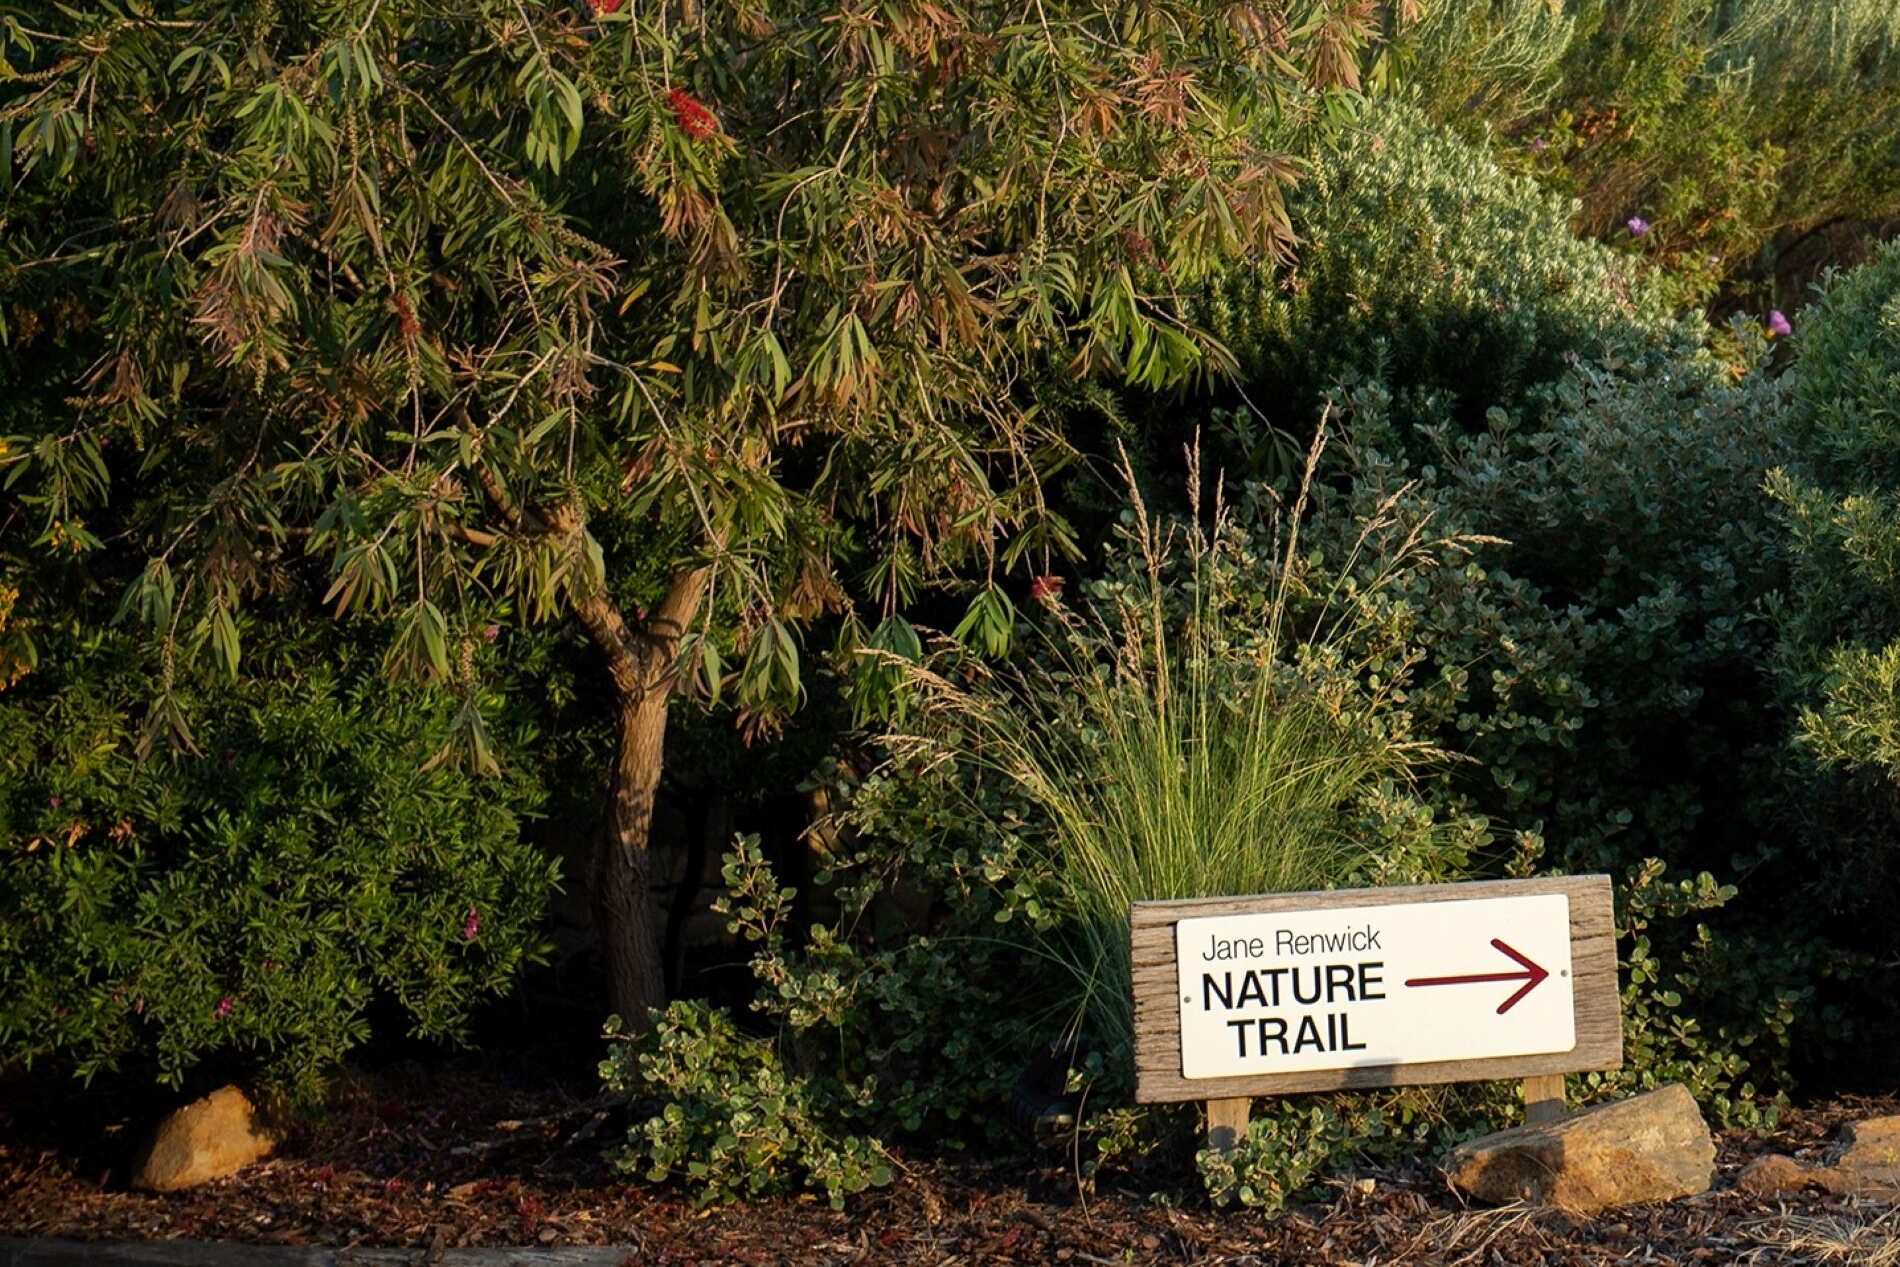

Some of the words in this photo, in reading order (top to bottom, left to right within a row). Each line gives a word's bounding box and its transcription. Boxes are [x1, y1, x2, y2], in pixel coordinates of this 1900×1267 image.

[1202, 934, 1264, 961] Jane
[1275, 924, 1382, 954] Renwick
[1202, 961, 1386, 1011] NATURE
[1227, 1012, 1367, 1058] TRAIL
